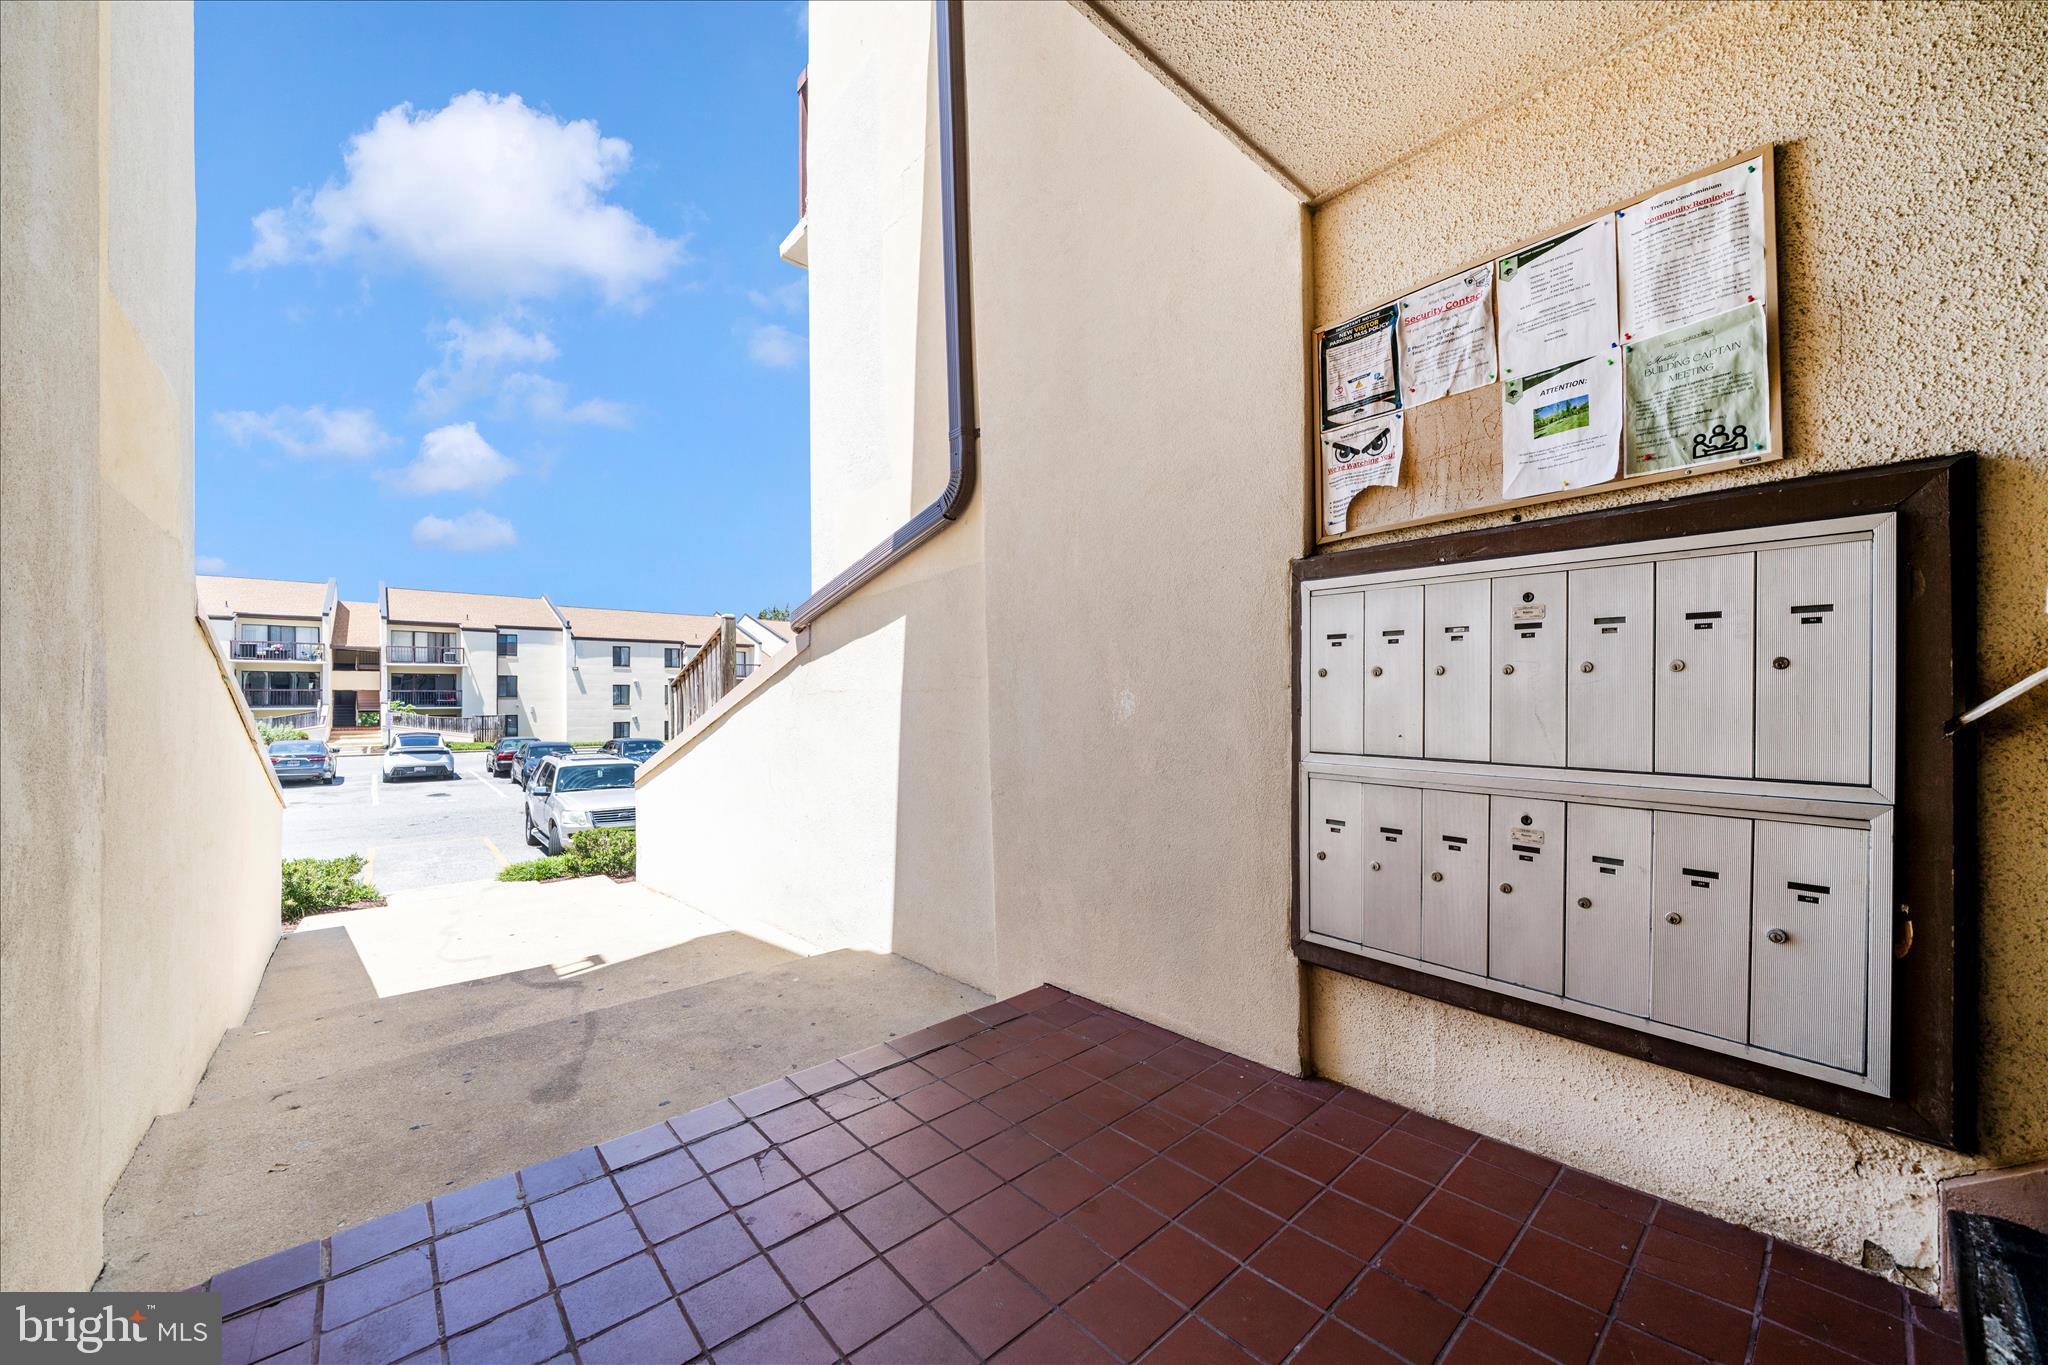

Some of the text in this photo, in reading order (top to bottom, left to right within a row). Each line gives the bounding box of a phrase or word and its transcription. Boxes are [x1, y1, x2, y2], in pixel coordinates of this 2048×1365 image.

[1644, 188, 1735, 225] Community Reminder
[1361, 312, 1380, 323] NOTICE
[1404, 306, 1444, 326] Security
[1329, 320, 1390, 347] PARKING PASS POLICY
[1339, 319, 1379, 339] NEW VISITOR
[1644, 340, 1742, 377] BUILDING CAPTAIN
[1646, 351, 1680, 367] Monthly
[1668, 362, 1715, 382] MEETING
[1540, 378, 1588, 398] ATTENTION:
[1347, 458, 1379, 470] Watching
